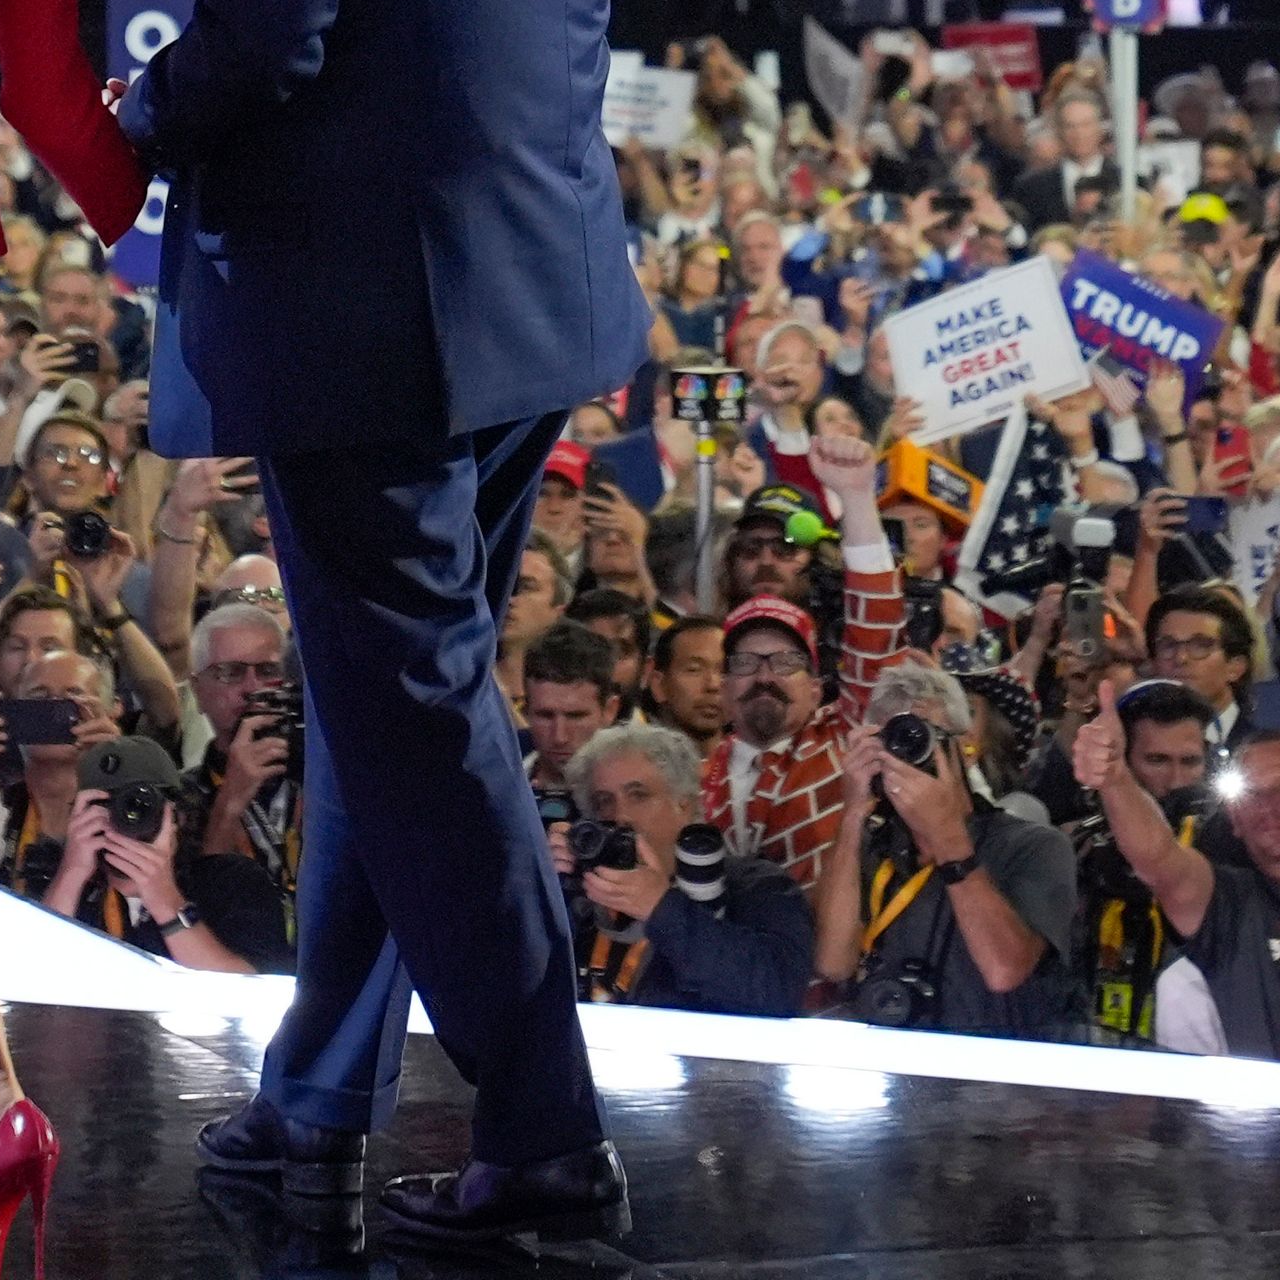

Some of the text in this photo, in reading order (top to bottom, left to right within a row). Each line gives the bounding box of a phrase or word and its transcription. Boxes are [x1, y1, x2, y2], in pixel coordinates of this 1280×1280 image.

[922, 314, 1034, 369] AMERICA
[934, 297, 1005, 339] MAKE
[1071, 277, 1202, 363] TRUMP
[1073, 313, 1156, 374] VANC
[942, 340, 1021, 385] GREAT
[948, 362, 1036, 410] AGAIN!
